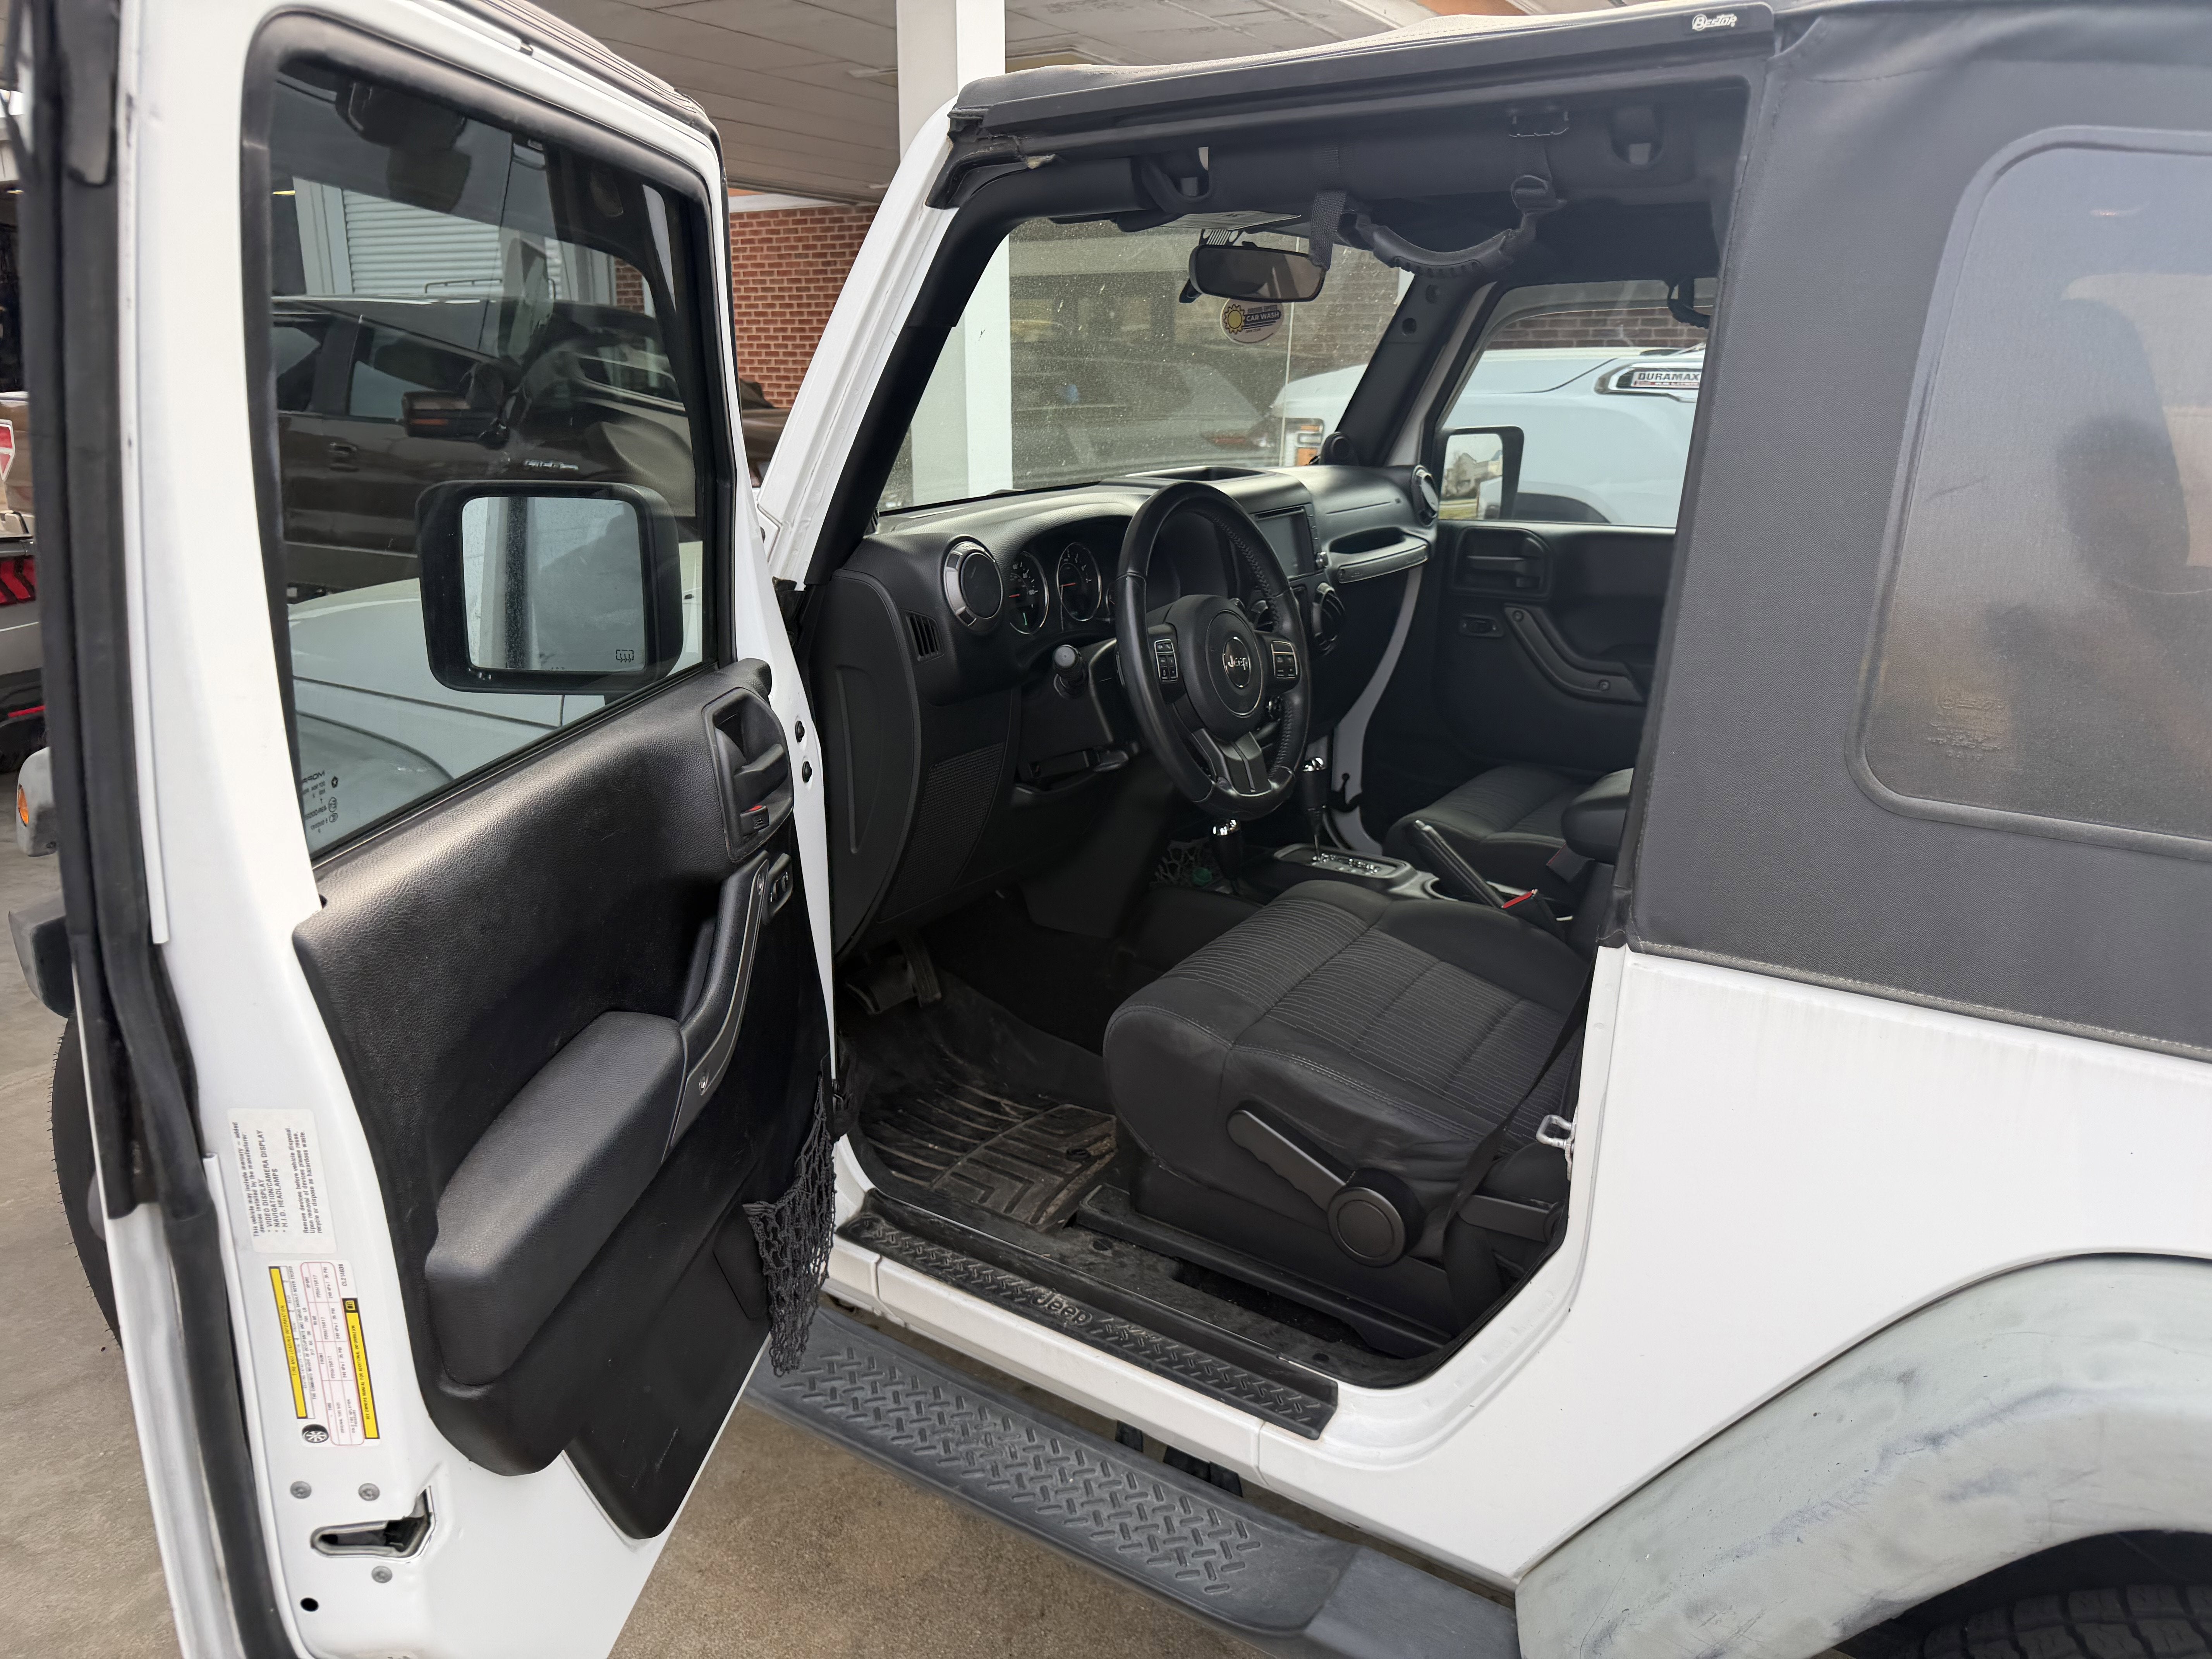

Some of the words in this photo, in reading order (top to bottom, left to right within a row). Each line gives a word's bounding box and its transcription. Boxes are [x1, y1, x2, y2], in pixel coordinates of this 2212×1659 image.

[1260, 311, 1280, 320] WASH
[1227, 655, 1249, 671] Jeep
[232, 1122, 240, 1138] added
[284, 1126, 295, 1150] disposal.
[256, 1130, 267, 1157] DISPLAY
[238, 1148, 247, 1170] mercury
[289, 1152, 298, 1171] vehicle
[295, 1150, 305, 1167] please
[302, 1150, 312, 1176] hazardous
[242, 1172, 251, 1191] include
[271, 1168, 284, 1207] HEADLAMPS
[293, 1173, 301, 1189] before
[299, 1169, 308, 1188] devices
[252, 1189, 261, 1211] installed
[258, 1179, 269, 1206] DISPLAY
[262, 1160, 280, 1226] NAVIGATION/CAMERA
[296, 1191, 305, 1210] devices
[309, 1186, 318, 1206] dispose
[248, 1206, 257, 1224] vehicle
[263, 1208, 273, 1226] VIDEO
[304, 1197, 313, 1218] removal
[256, 1213, 265, 1232] devices
[279, 1209, 288, 1226] H.I.D.
[300, 1212, 309, 1233] Remove
[308, 1220, 316, 1233] Upon
[314, 1215, 323, 1233] recycle
[1032, 1291, 1092, 1325] Jeep
[279, 1305, 290, 1334] INFORMATION
[285, 1336, 294, 1354] LOADING
